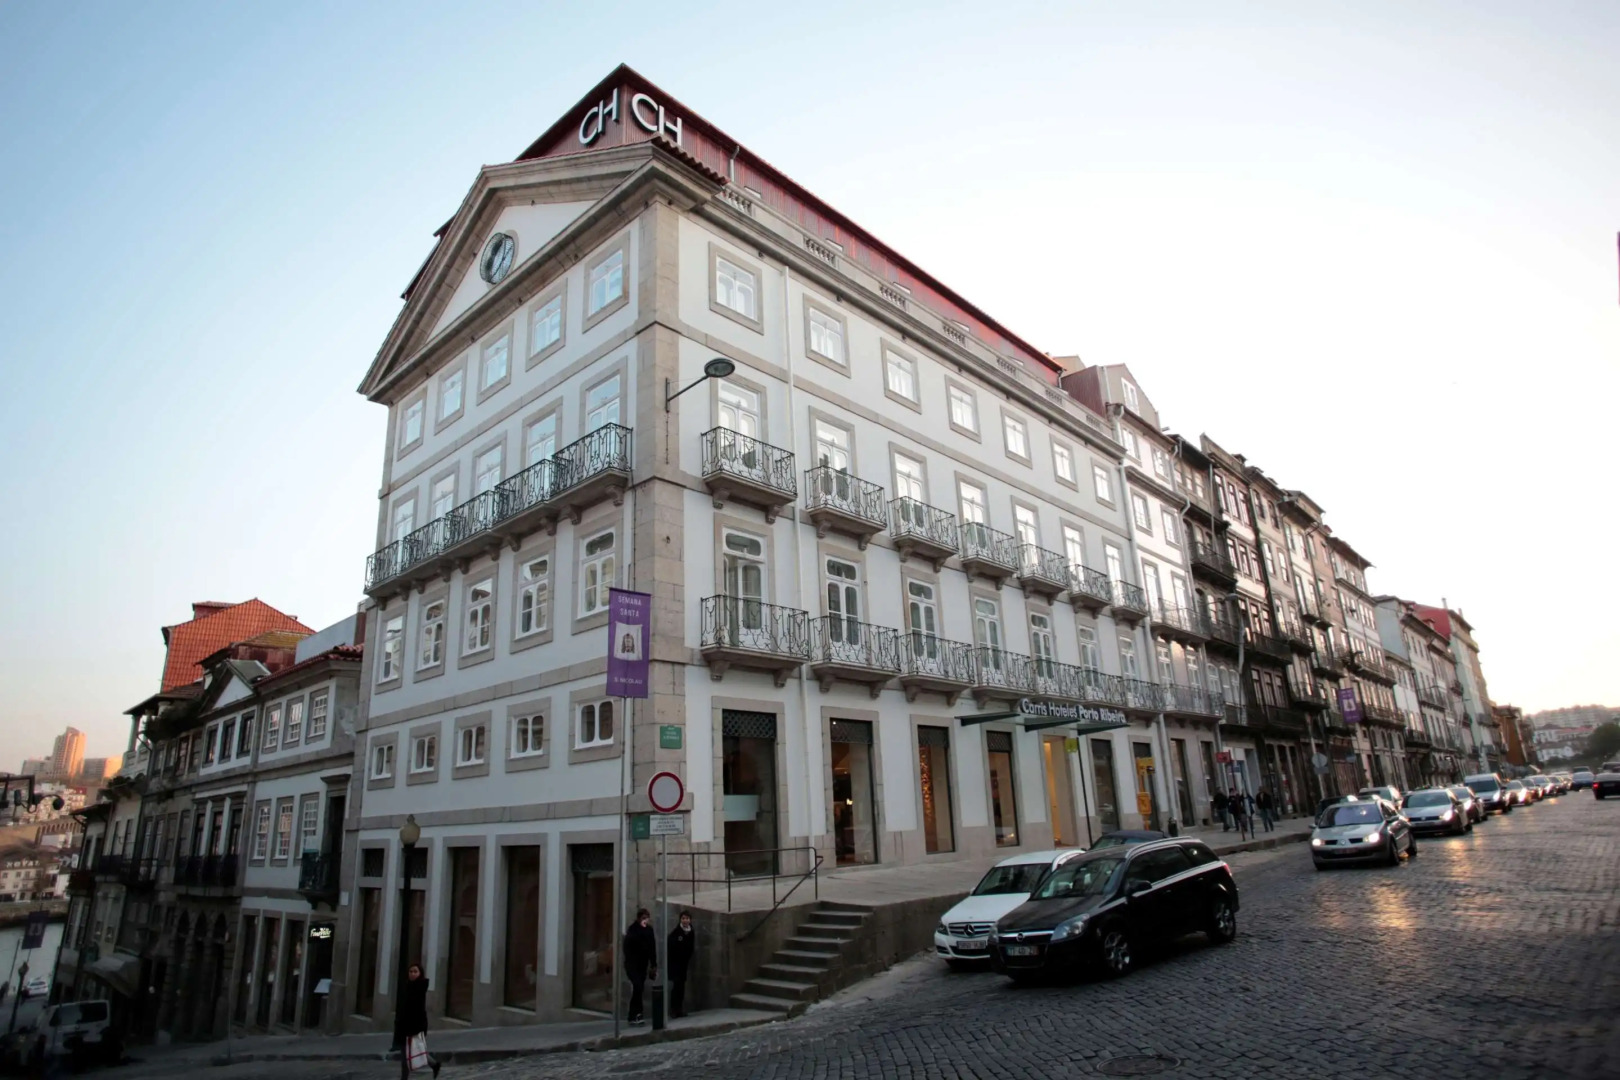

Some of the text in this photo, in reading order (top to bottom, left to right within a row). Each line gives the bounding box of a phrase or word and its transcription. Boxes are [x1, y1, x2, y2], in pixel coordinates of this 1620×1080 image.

[579, 88, 618, 145] CH
[632, 93, 682, 147] CH
[618, 595, 642, 606] SEMANA
[619, 607, 640, 617] SANTA
[1048, 701, 1077, 718] Hoteles
[1078, 704, 1099, 720] Porto
[1100, 708, 1126, 723] Ribeira
